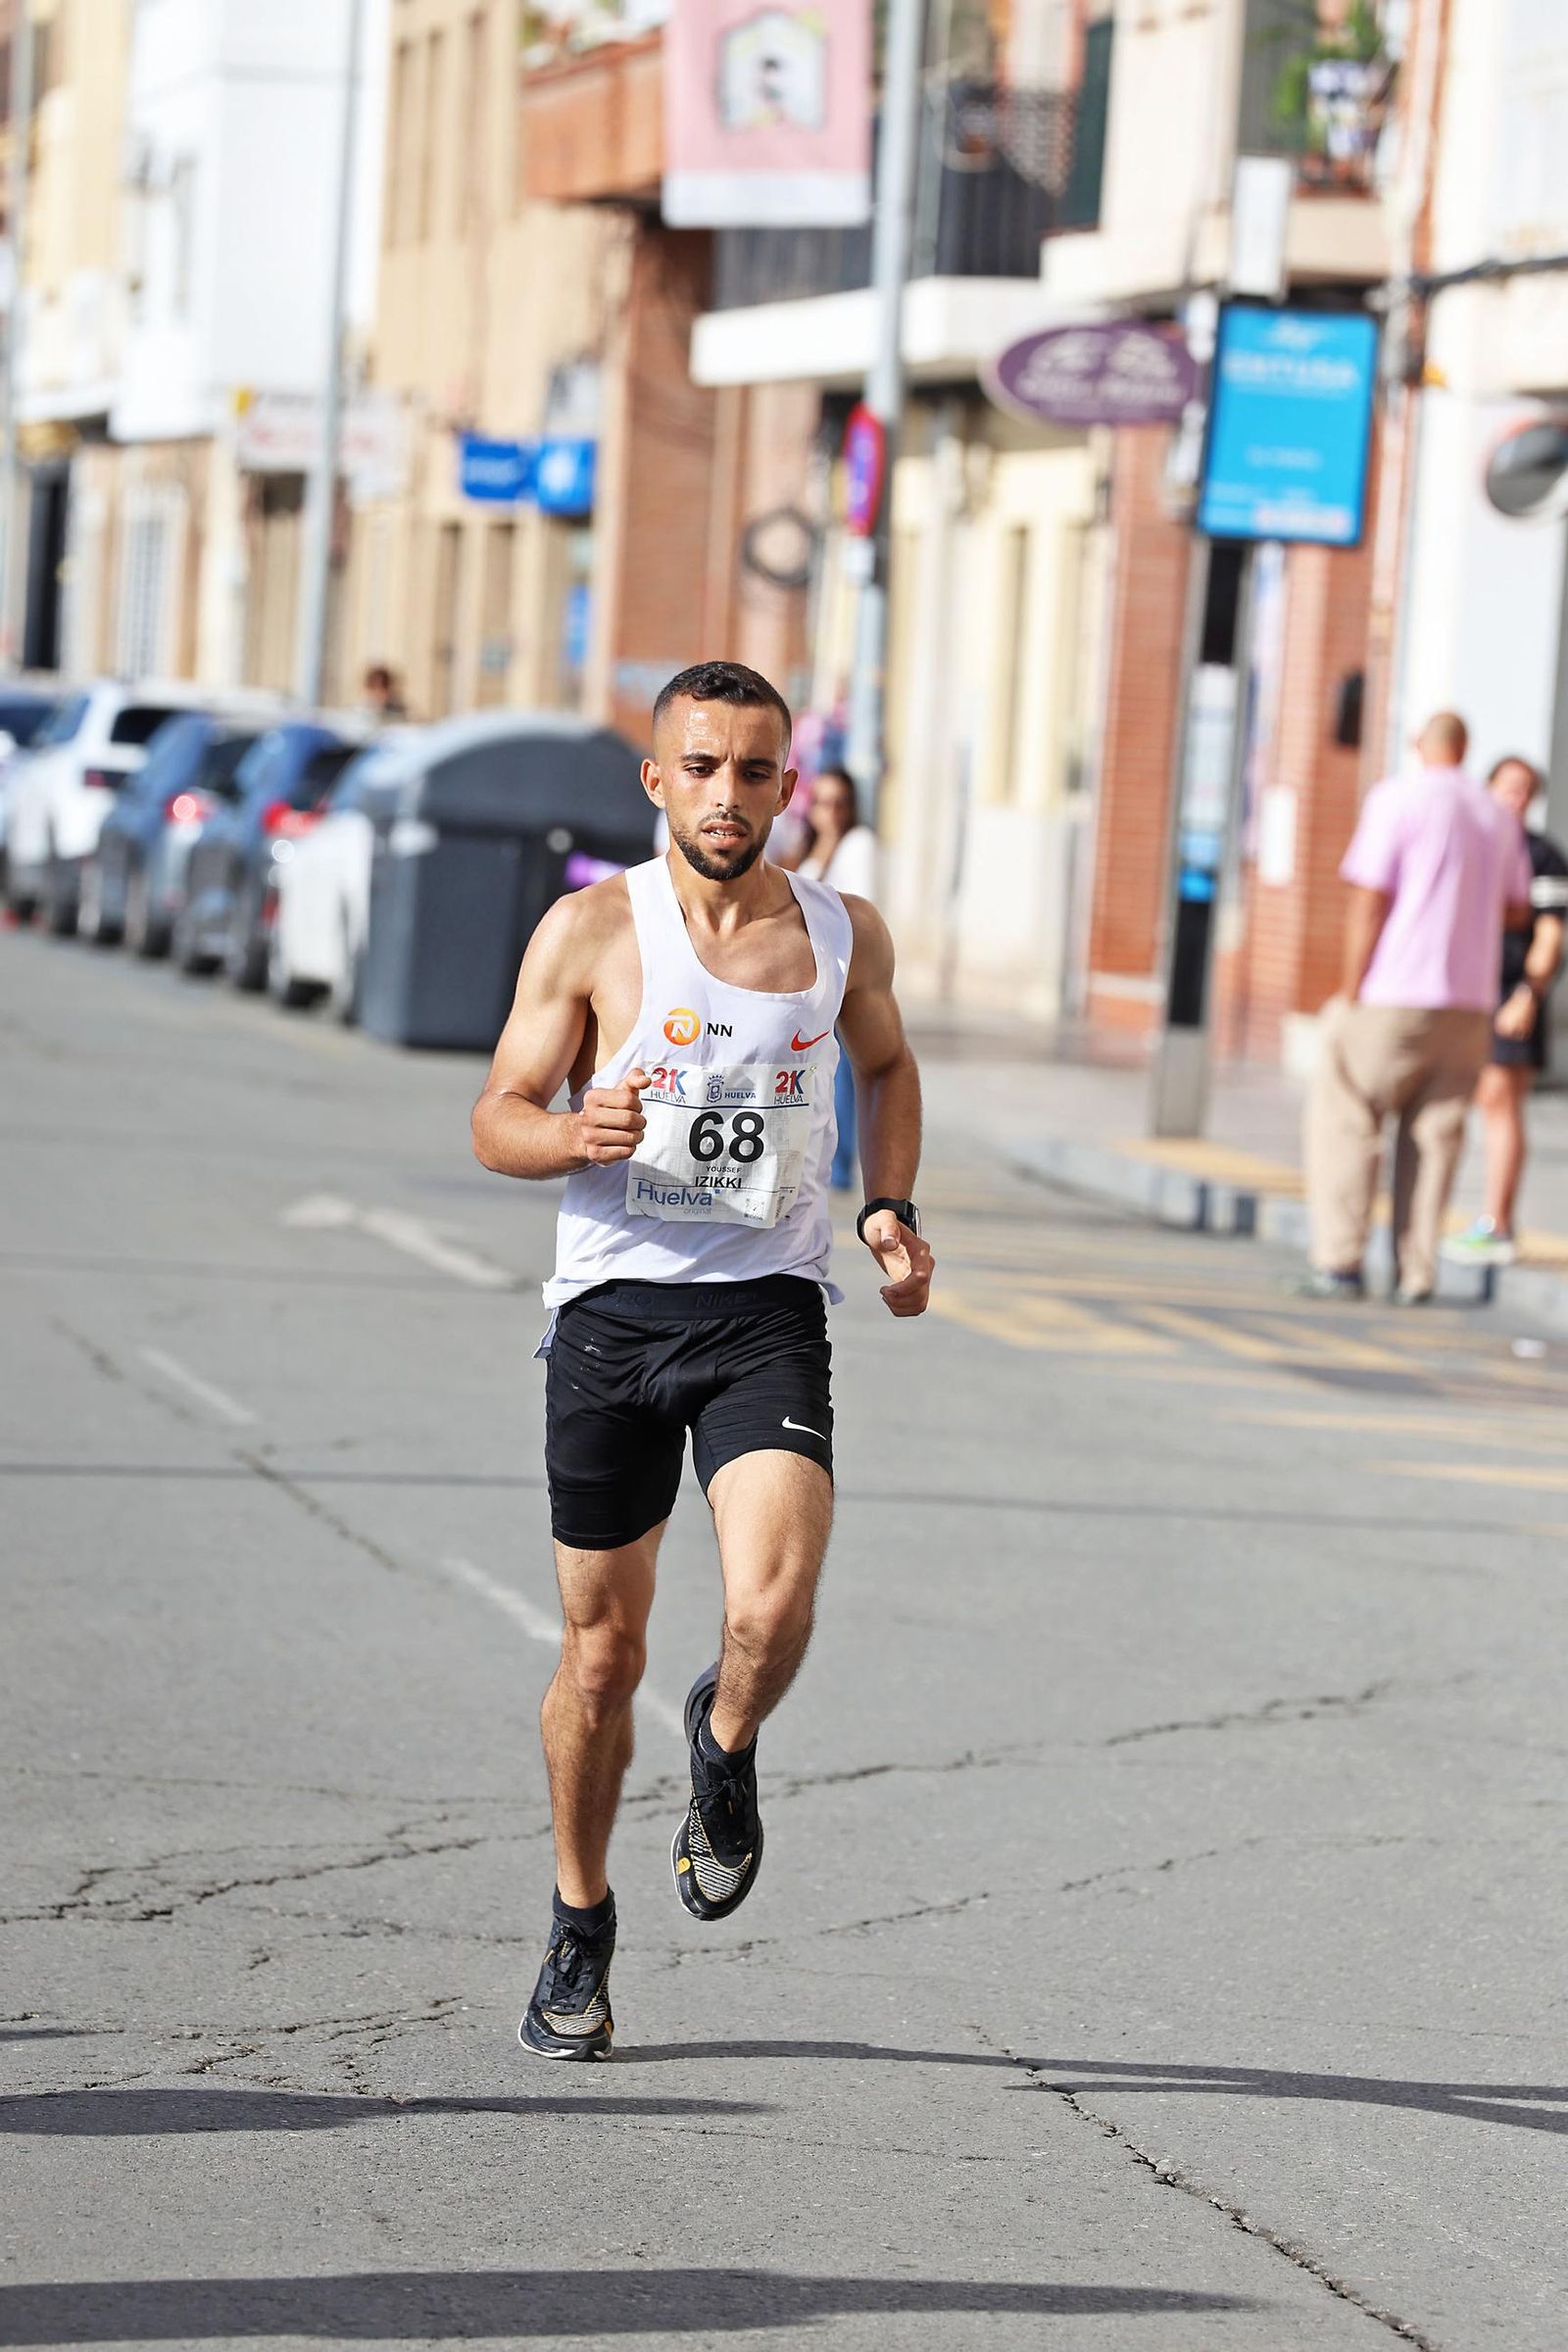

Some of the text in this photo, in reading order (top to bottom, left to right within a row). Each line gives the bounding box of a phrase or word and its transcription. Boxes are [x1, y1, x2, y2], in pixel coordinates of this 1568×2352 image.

[707, 1022, 733, 1038] NN
[651, 1067, 687, 1096] 21K
[774, 1069, 806, 1095] 21K
[650, 1090, 686, 1104] HUELVA
[773, 1094, 804, 1105] HUELVA
[689, 1110, 764, 1163] 68
[695, 1176, 742, 1189] IZIKKI
[637, 1181, 712, 1206] Huelva
